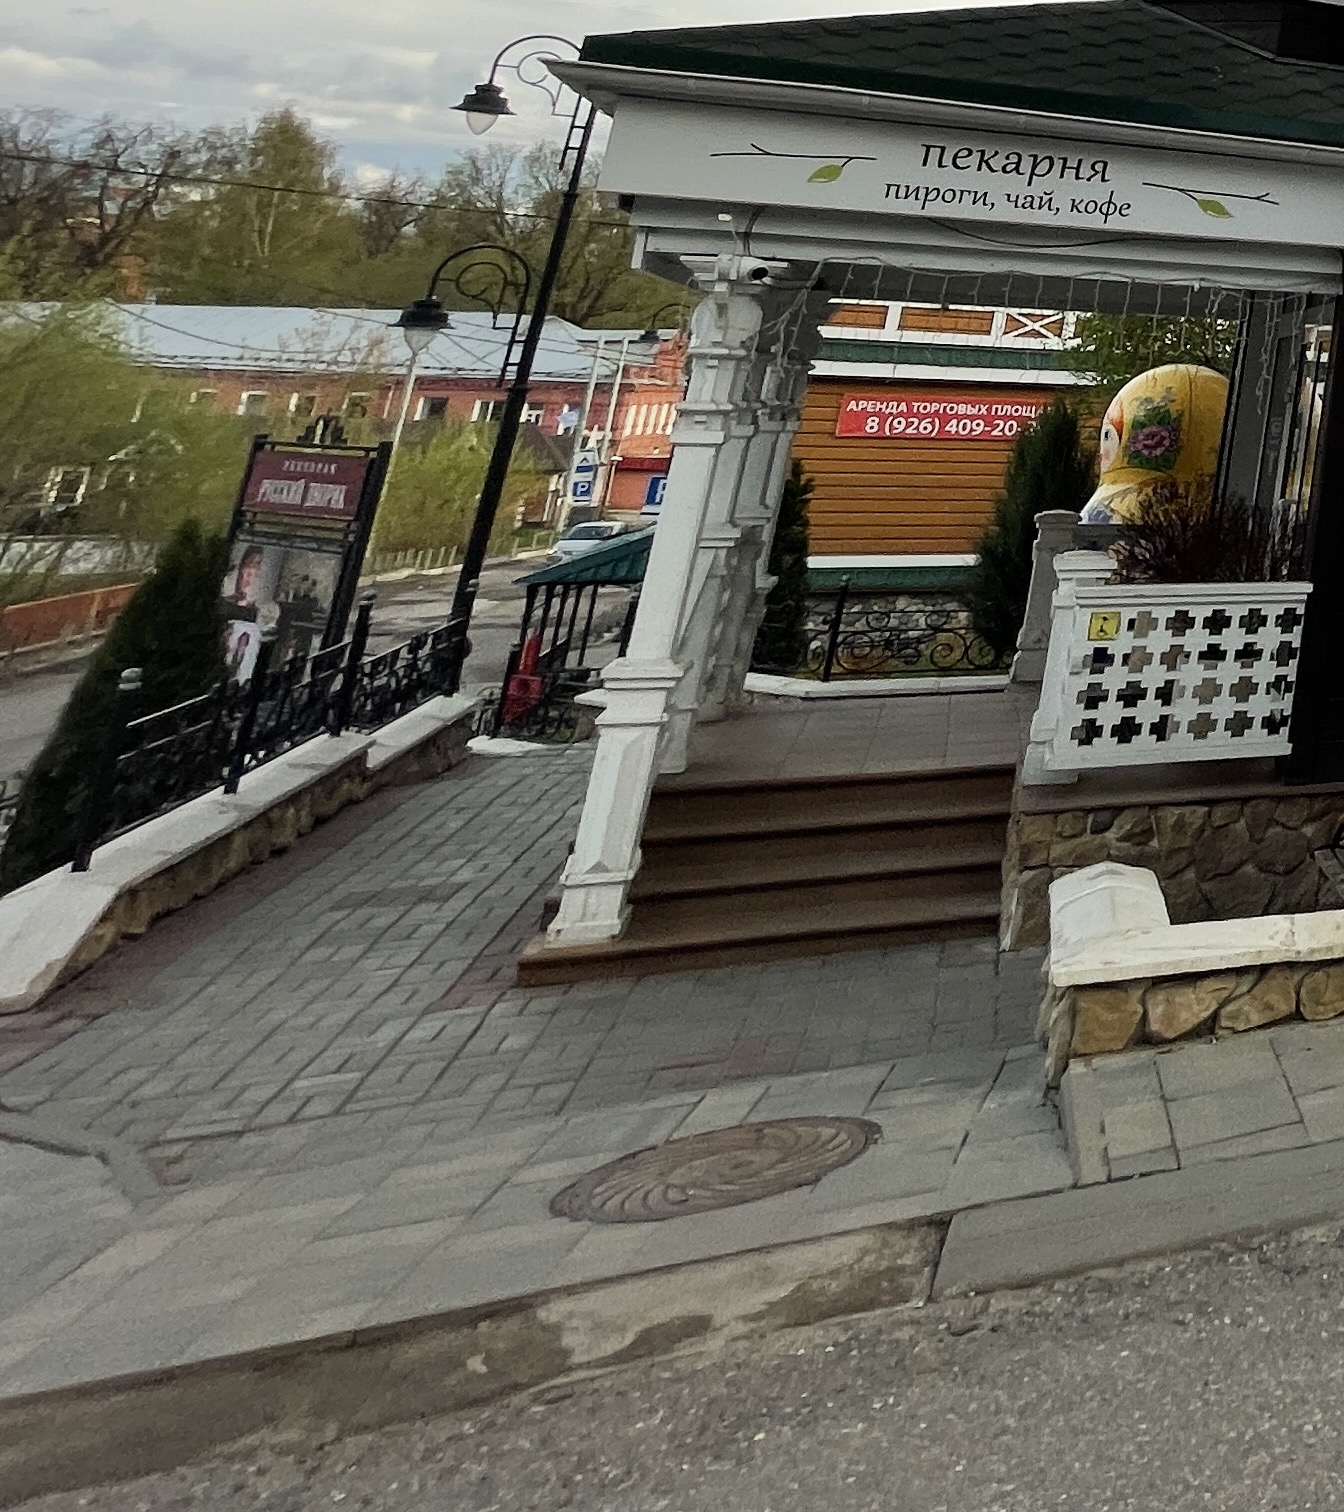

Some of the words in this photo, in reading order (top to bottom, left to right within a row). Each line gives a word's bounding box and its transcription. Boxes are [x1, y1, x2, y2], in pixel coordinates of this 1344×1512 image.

[920, 143, 1111, 187] пекарня
[884, 182, 996, 211] пироги,
[1004, 189, 1061, 216] чай,
[1069, 190, 1132, 224] кофе
[846, 399, 908, 414] АРЕНДА
[911, 401, 988, 416] ТОРГОВЫХ
[864, 416, 880, 434] 8
[885, 416, 940, 437] (926)
